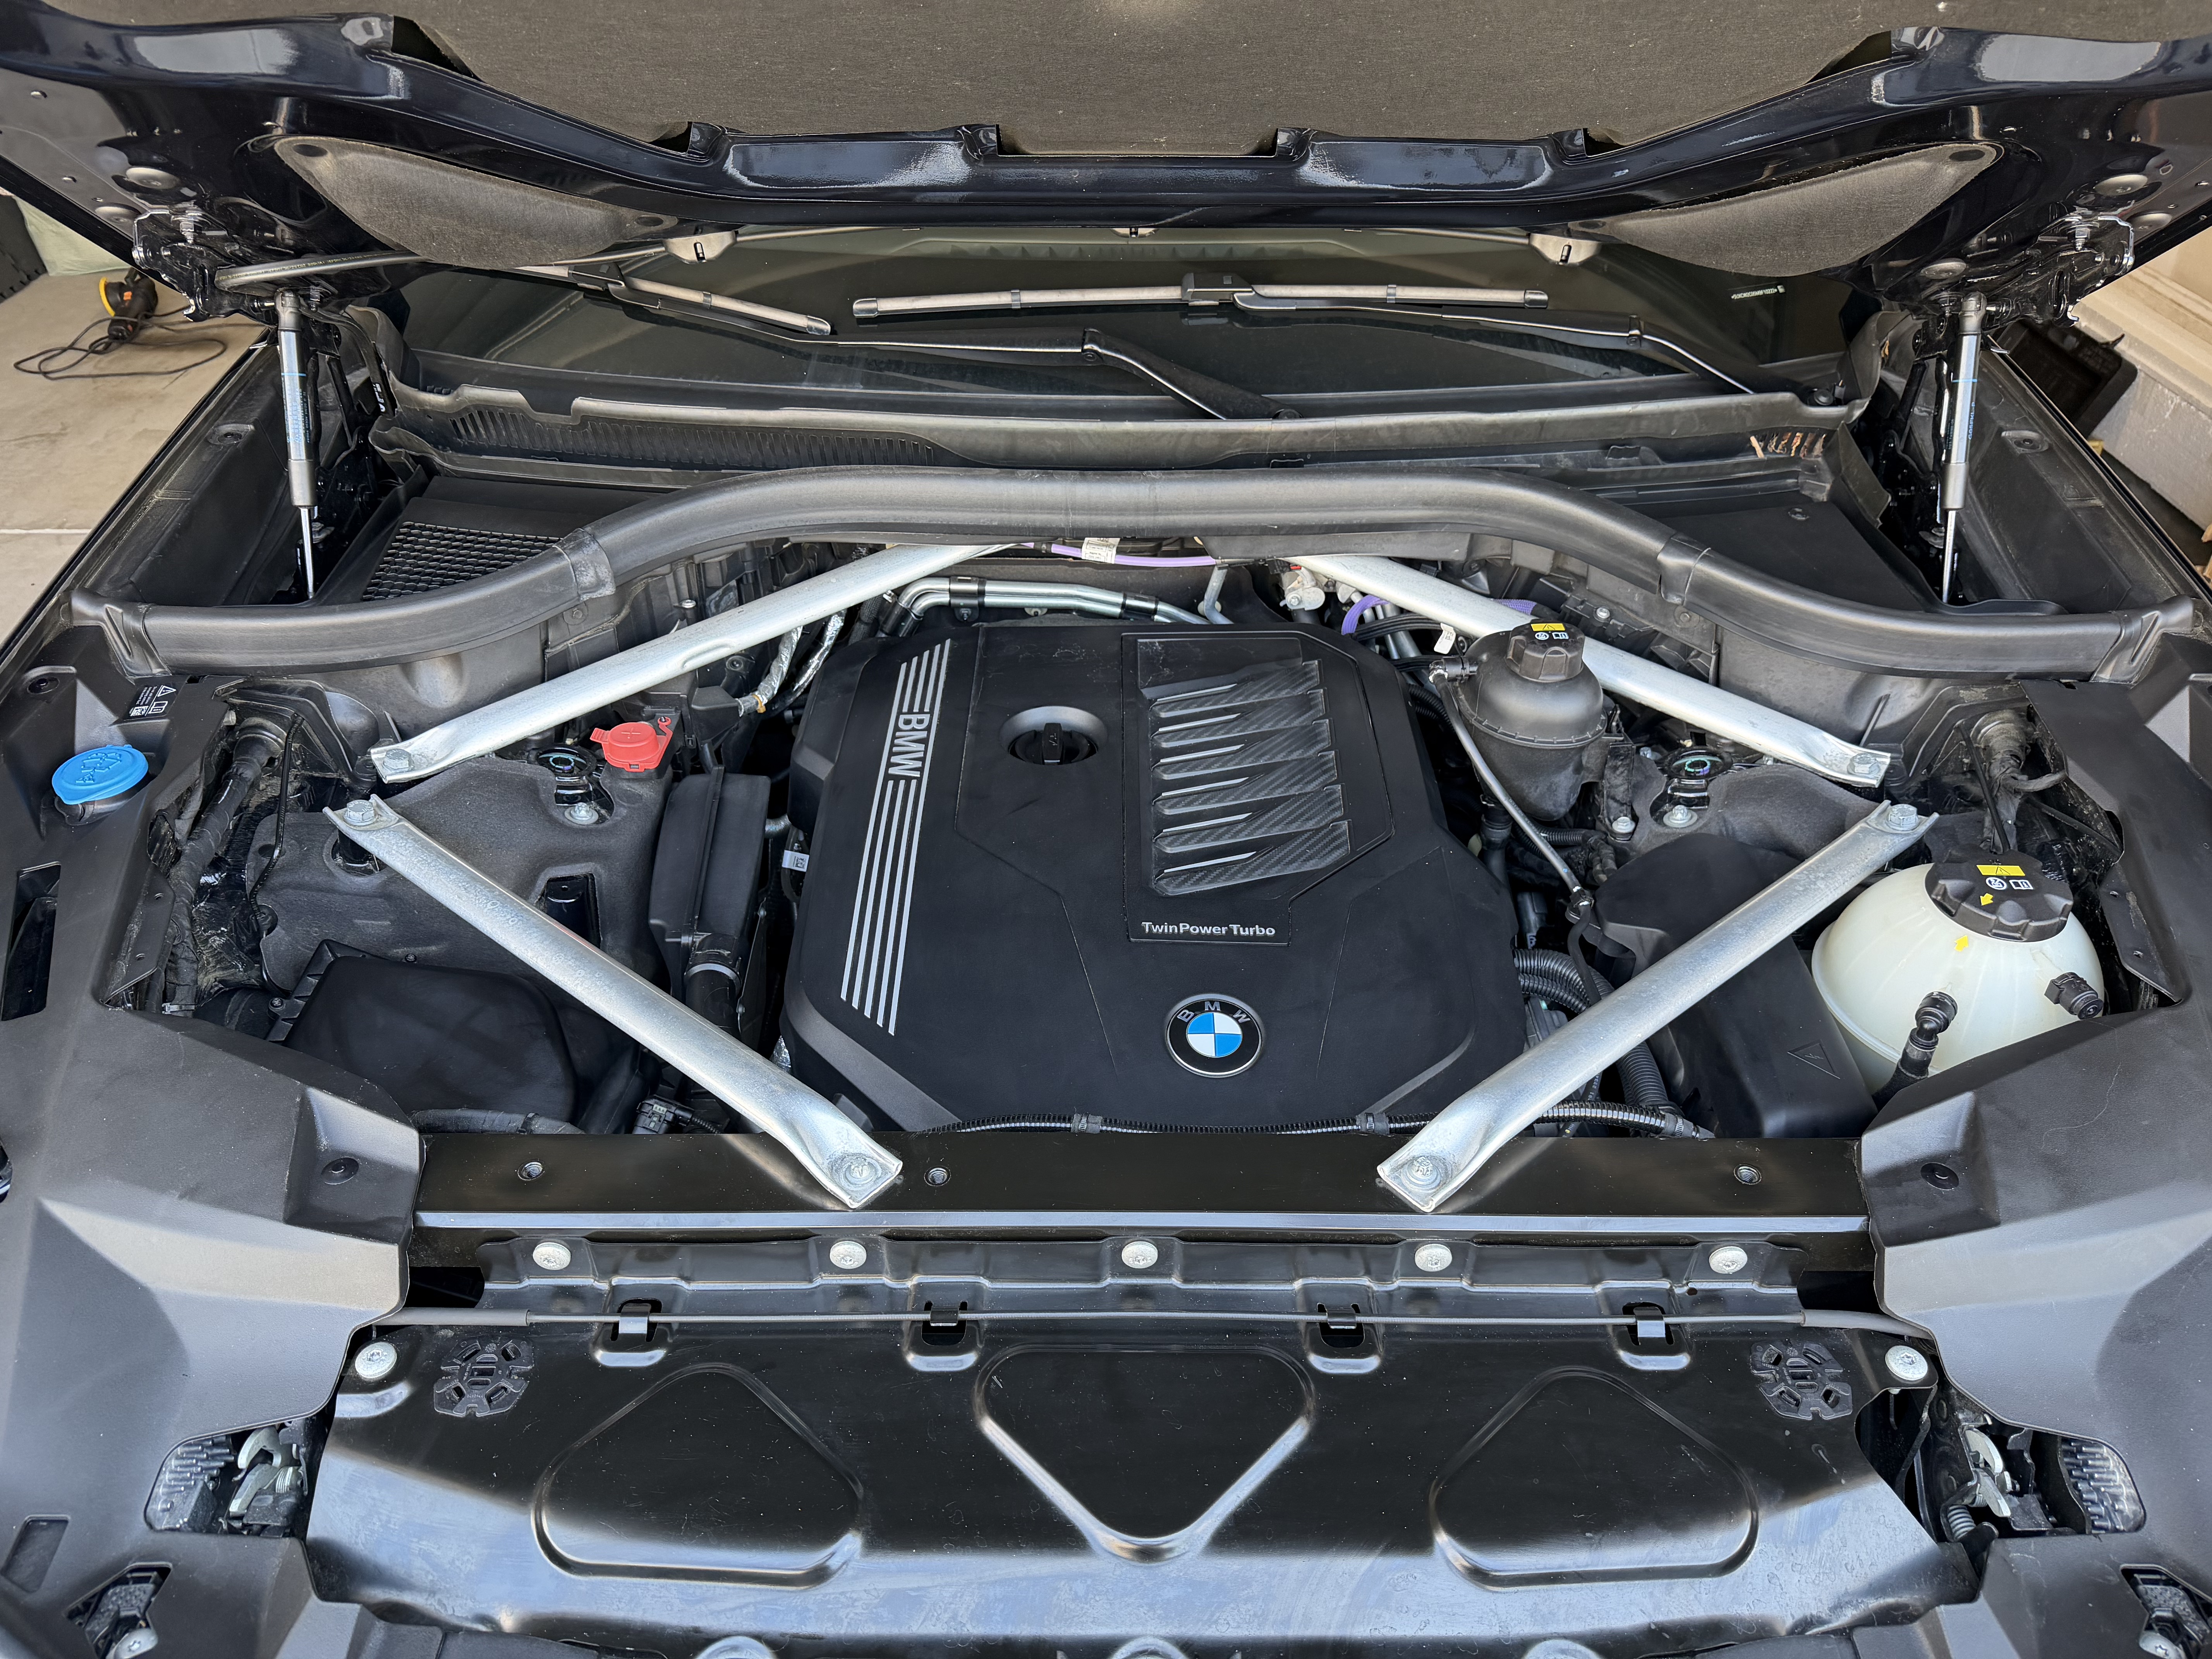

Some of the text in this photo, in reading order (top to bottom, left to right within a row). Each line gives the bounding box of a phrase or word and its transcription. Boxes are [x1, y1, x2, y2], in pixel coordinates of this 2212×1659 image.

[888, 714, 930, 777] BMW
[1229, 924, 1276, 936] Turbo
[1176, 1001, 1251, 1024] BMW
